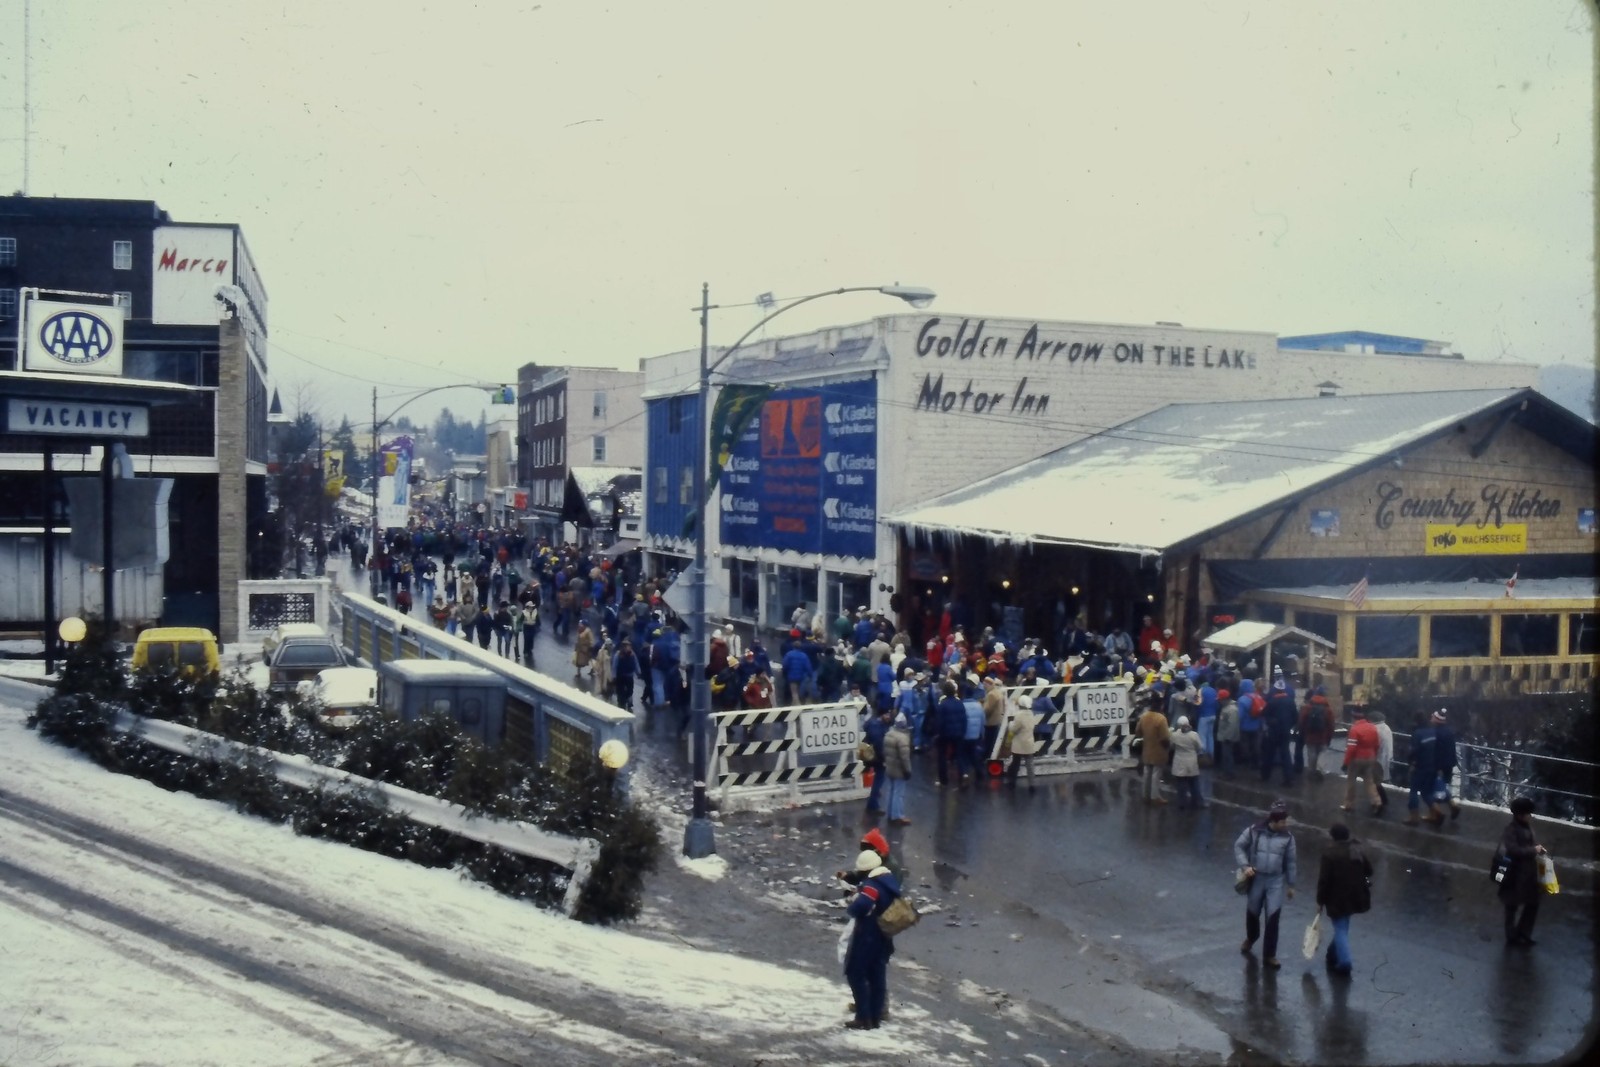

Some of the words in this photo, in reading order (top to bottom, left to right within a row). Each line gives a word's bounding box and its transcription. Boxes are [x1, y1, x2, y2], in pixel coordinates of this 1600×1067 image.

[157, 247, 228, 276] Marcy
[50, 314, 103, 358] AAA
[916, 317, 1008, 360] Golden
[1014, 323, 1104, 363] Arrow
[1114, 342, 1144, 364] ON
[1153, 345, 1195, 367] THE
[1203, 346, 1257, 370] LAKE
[53, 352, 99, 364] APPROVED
[915, 372, 1005, 414] Motor
[1010, 376, 1051, 415] Inn
[26, 406, 132, 430] VACANCY
[1375, 481, 1475, 530] Country
[1476, 483, 1561, 529] Kitchen
[1462, 534, 1522, 545] WACHSSERVICE
[1087, 692, 1118, 704] ROAD
[812, 714, 848, 729] ROAD
[1081, 707, 1125, 721] CLOSED
[805, 731, 856, 748] CLOSED
